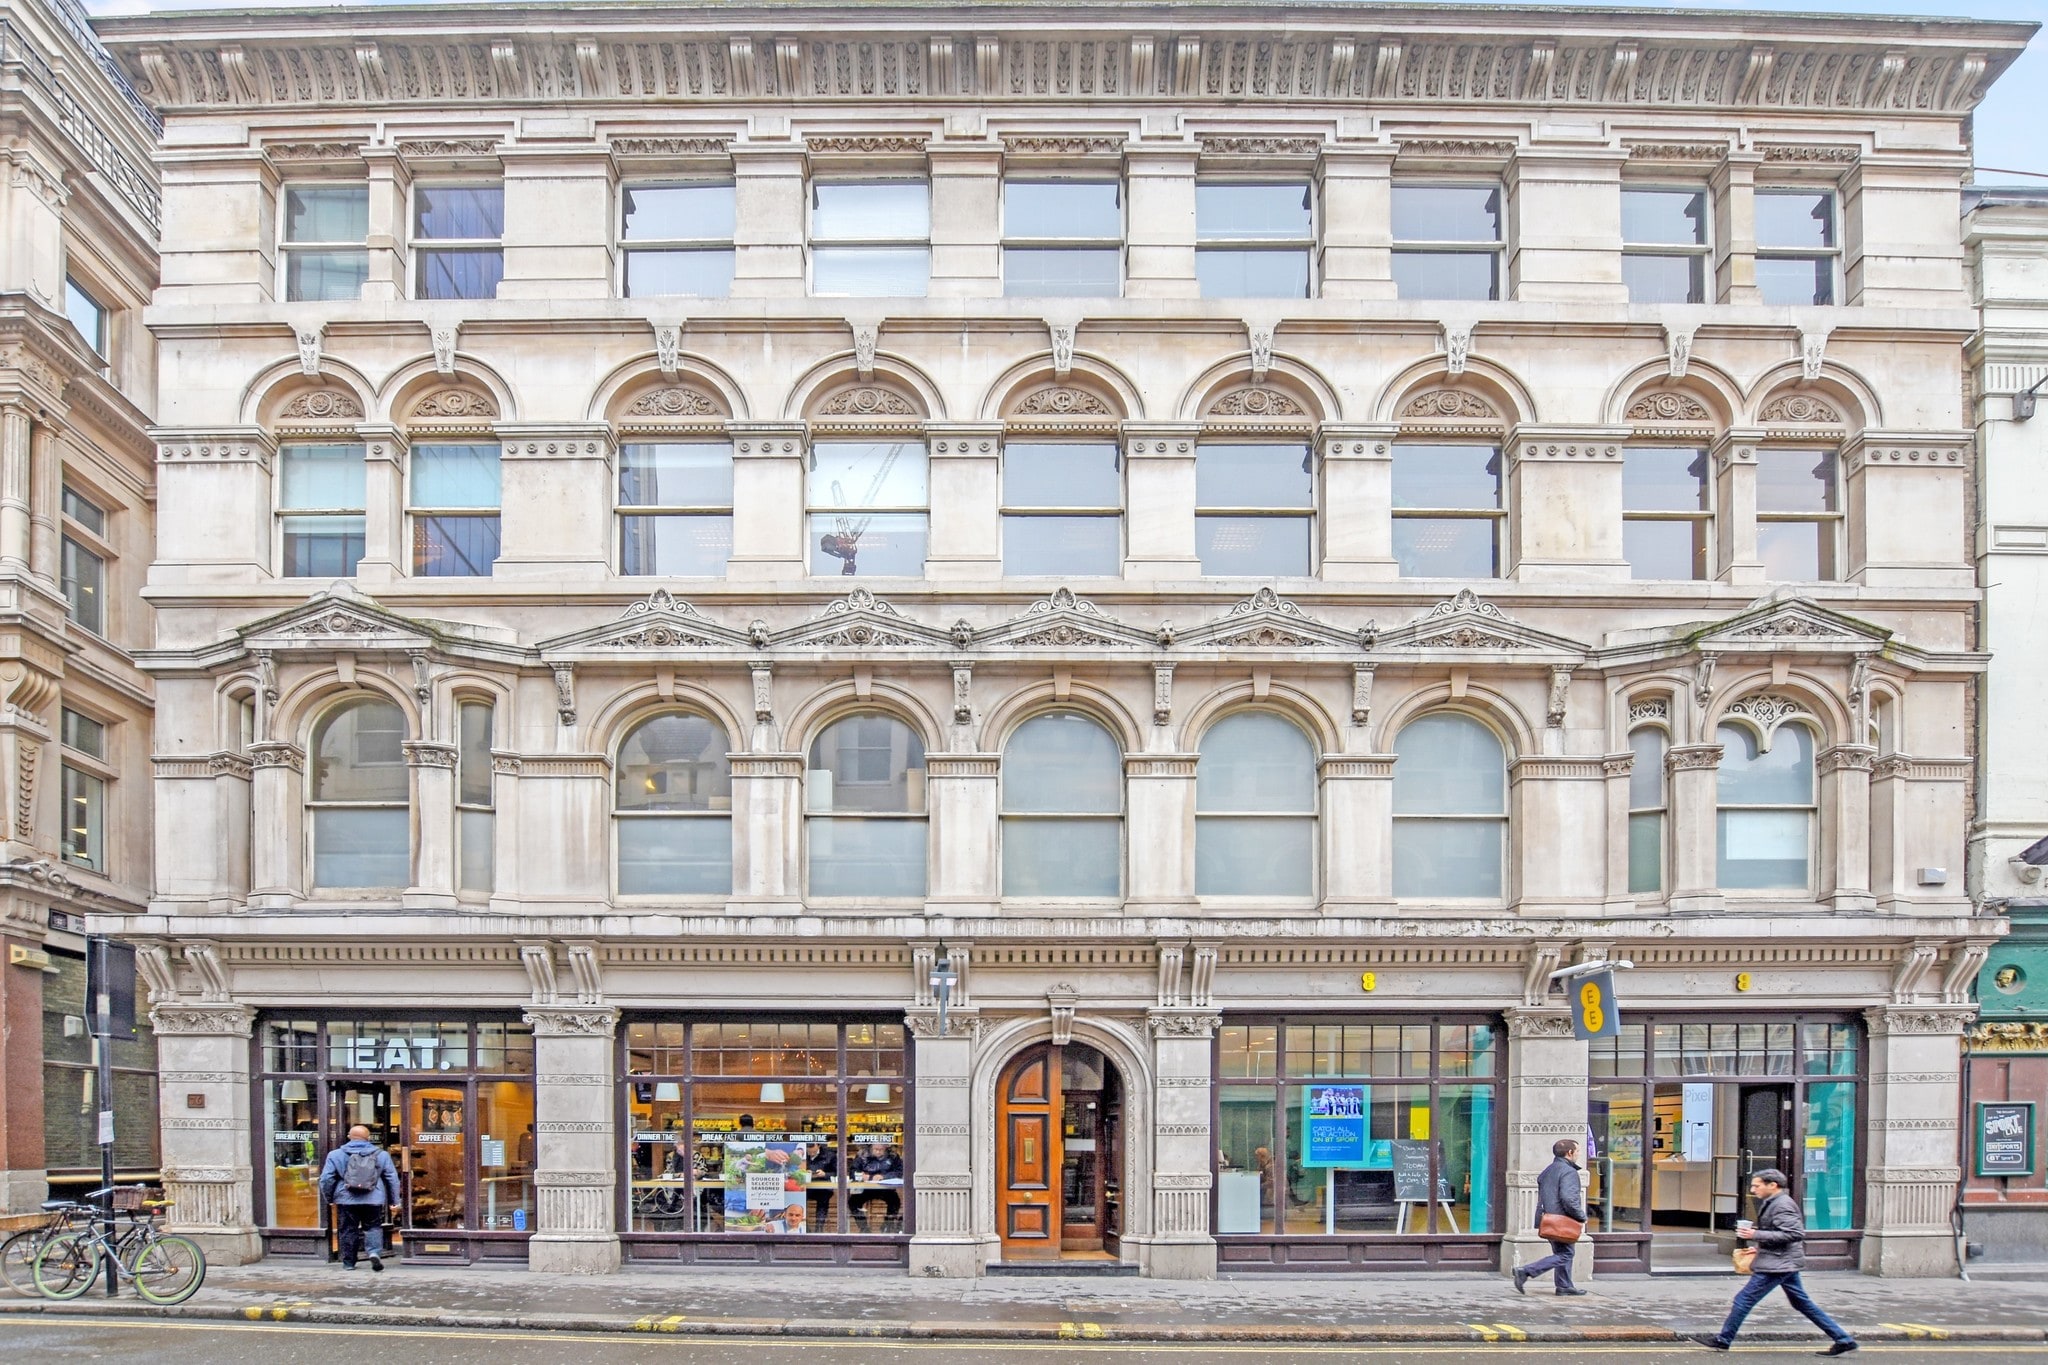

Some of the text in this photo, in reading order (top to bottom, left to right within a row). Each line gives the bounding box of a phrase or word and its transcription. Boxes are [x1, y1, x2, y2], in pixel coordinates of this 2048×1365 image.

[347, 1038, 450, 1070] EAT.
[1685, 1088, 1711, 1102] Pixel
[418, 1134, 442, 1142] COFFEE
[637, 1133, 675, 1141] DINNER TIME
[701, 1133, 723, 1141] BREAK
[724, 1133, 738, 1141] FAST
[743, 1133, 765, 1141] LUNCH
[789, 1134, 813, 1142] DINNER
[814, 1134, 828, 1142] TIME
[854, 1134, 879, 1142] COFFEE
